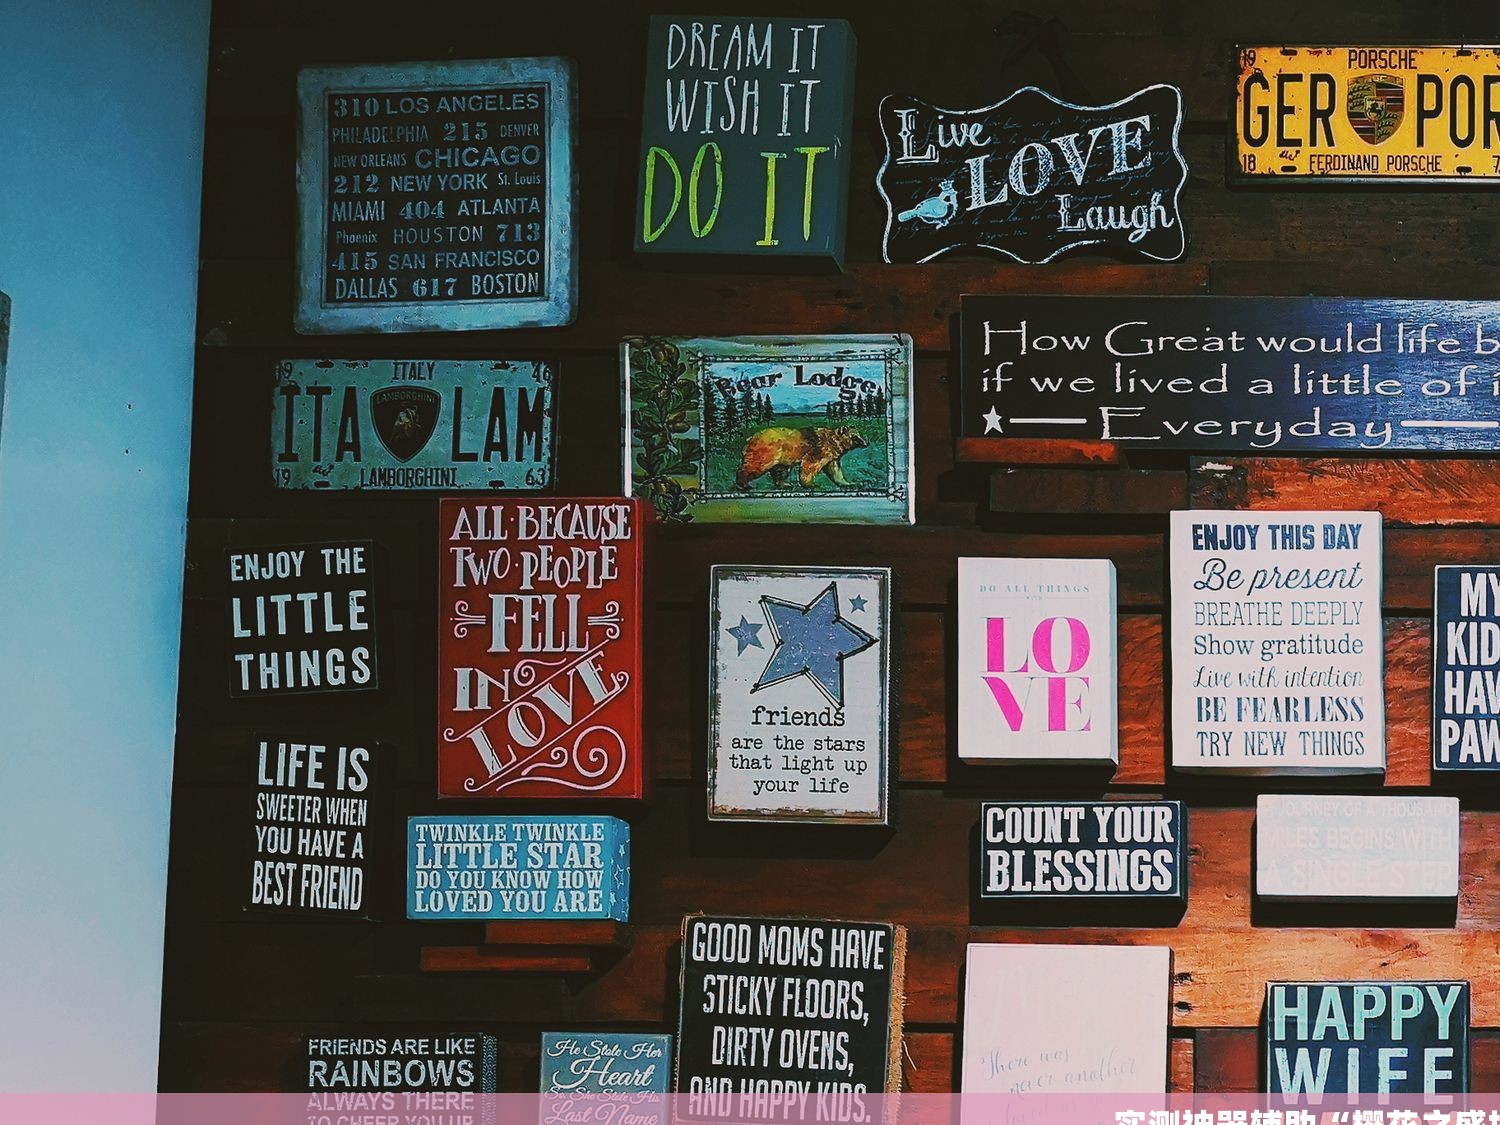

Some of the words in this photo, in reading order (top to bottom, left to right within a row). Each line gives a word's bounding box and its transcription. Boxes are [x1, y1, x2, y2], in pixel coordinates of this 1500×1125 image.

[667, 23, 772, 72] DREAM
[790, 24, 824, 73] IT
[1348, 50, 1418, 69] PORSCHE
[333, 97, 379, 118] 310
[386, 96, 430, 115] LOS
[437, 94, 539, 113] ANGELES
[667, 80, 759, 136] WISH
[778, 80, 820, 136] IT
[1243, 73, 1334, 148] GER
[644, 142, 722, 242] DO
[756, 147, 830, 245] IT
[335, 276, 398, 299] DALLAS
[413, 276, 455, 297] 617
[471, 272, 538, 295] BOSTON
[983, 322, 1089, 355] How
[1106, 322, 1245, 355] Great
[1257, 324, 1381, 354] would
[1397, 322, 1460, 354] life
[278, 386, 361, 462] ITA
[452, 386, 543, 462] LAM
[1101, 407, 1393, 447] Everyday
[1192, 525, 1259, 550] ENJOY
[1268, 525, 1315, 550] THIS
[1323, 524, 1362, 550] DAY
[231, 550, 304, 582] ENJOY
[321, 548, 366, 575] THE
[1194, 558, 1245, 591] Be
[1247, 563, 1363, 595] present
[232, 590, 369, 638] LITTLE
[488, 593, 589, 653] FELL
[1194, 635, 1254, 655] Show
[1261, 632, 1364, 661] gratitude
[235, 646, 371, 691] THINGS
[751, 705, 845, 727] friends
[258, 742, 326, 789] LIFE
[337, 748, 369, 792] IS
[754, 778, 798, 795] your
[809, 776, 849, 794] life
[986, 807, 1084, 843] COUNT
[1097, 806, 1173, 842] YOUR
[416, 844, 517, 869] LITTLE
[527, 843, 602, 869] STAR
[987, 849, 1173, 892] BLESSINGS
[252, 861, 296, 906] BEST
[301, 864, 362, 911] FRIEND
[692, 922, 754, 963] GOOD
[758, 926, 823, 967] MOMS
[829, 928, 884, 970] HAVE
[1275, 986, 1462, 1041] HAPPY
[309, 1060, 474, 1087] RAINBOWS
